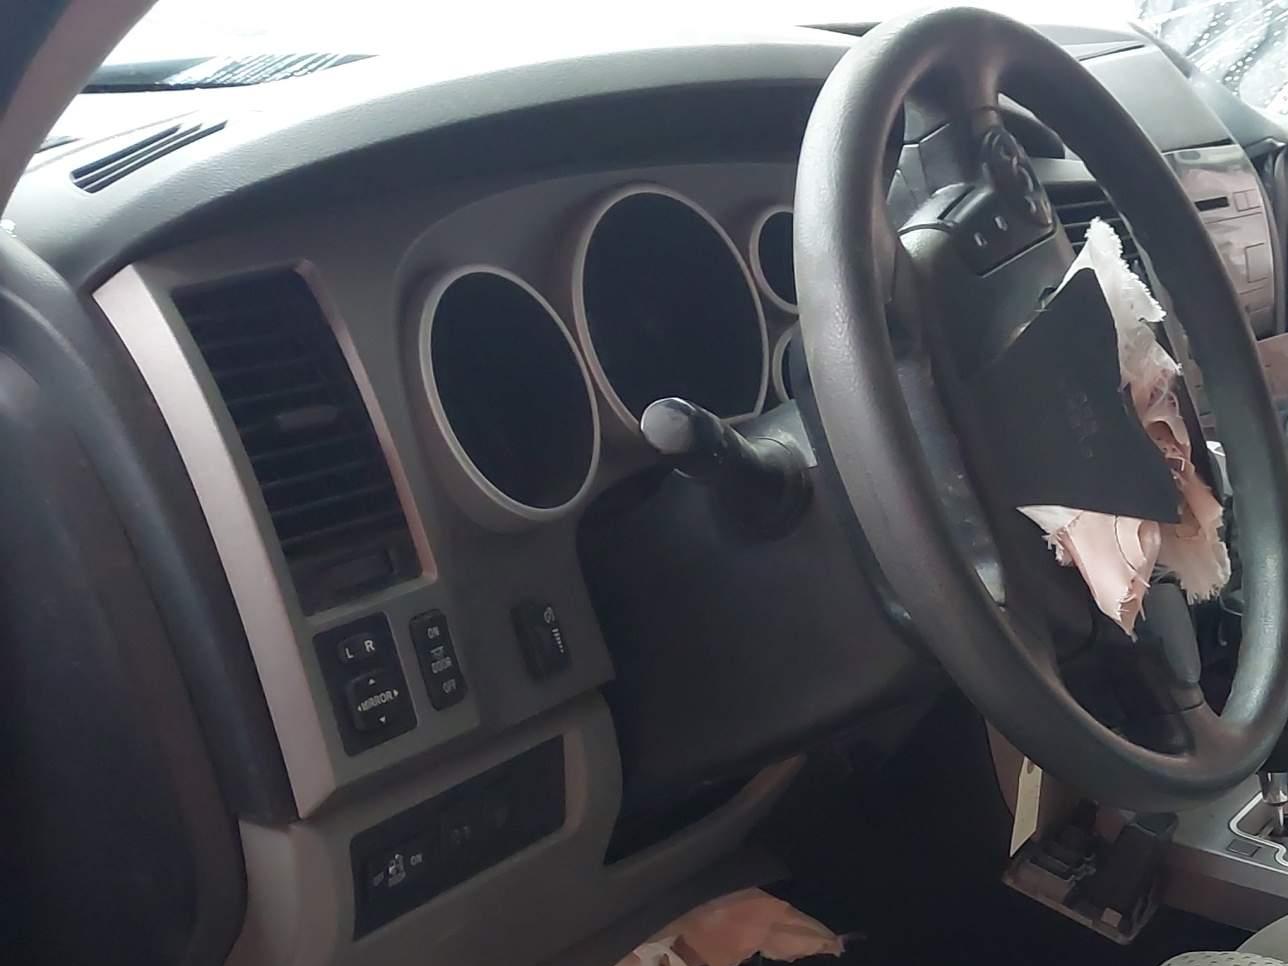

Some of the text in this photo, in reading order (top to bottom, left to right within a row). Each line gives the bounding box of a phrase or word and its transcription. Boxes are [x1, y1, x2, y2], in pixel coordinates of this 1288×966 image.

[427, 626, 440, 639] ON
[345, 640, 376, 659] L R
[442, 678, 457, 694] OFF
[361, 690, 393, 711] MIRROR
